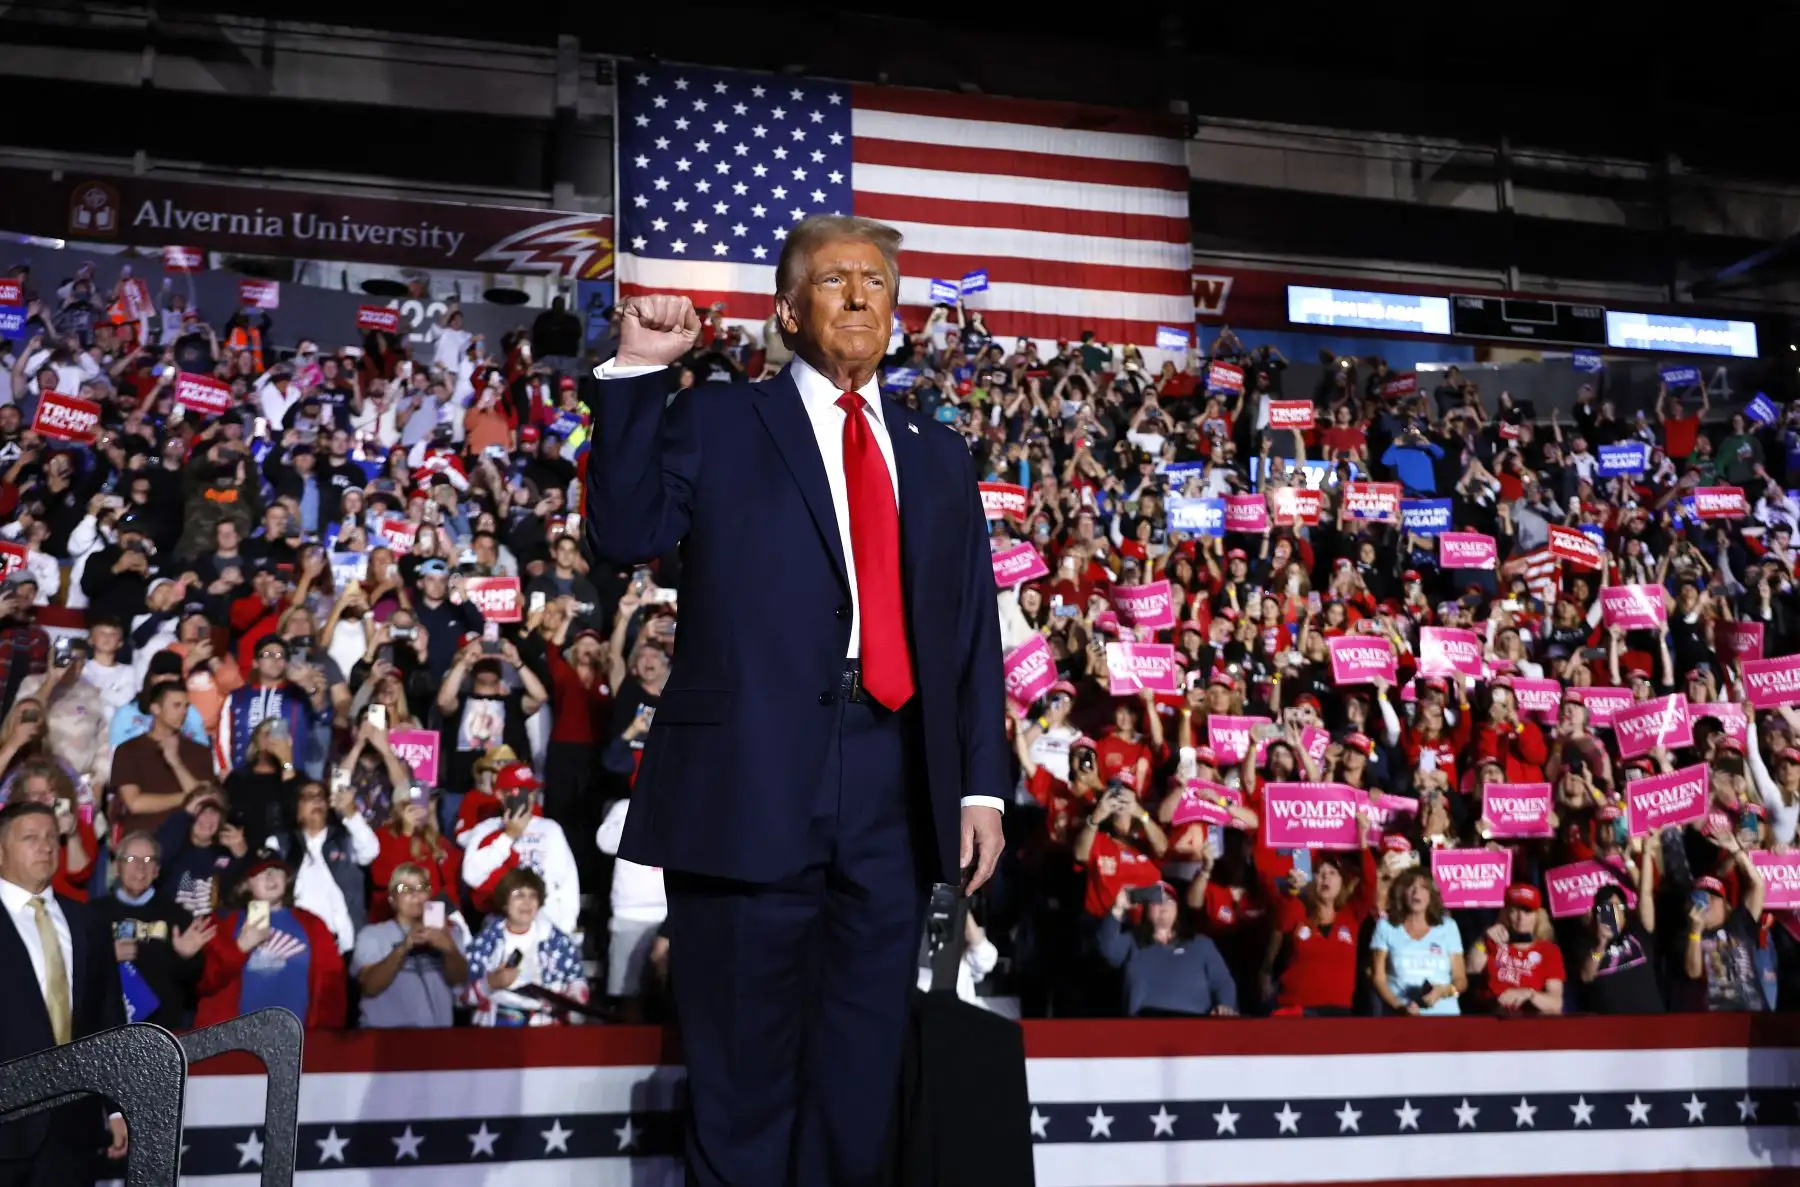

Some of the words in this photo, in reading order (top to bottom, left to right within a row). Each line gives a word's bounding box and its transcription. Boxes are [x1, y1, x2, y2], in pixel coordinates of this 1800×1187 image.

[133, 199, 284, 237] Alvernia
[292, 211, 465, 257] University
[387, 299, 448, 342] 22
[42, 402, 98, 425] TRUMP
[1271, 408, 1312, 418] TRUMP
[1347, 493, 1378, 501] DREAM
[1348, 499, 1392, 511] AGAIN!
[1402, 508, 1432, 516] DREAM
[1404, 514, 1447, 527] AGAIN!
[384, 529, 415, 545] TRU
[1444, 540, 1492, 553] WOMEN
[1336, 646, 1391, 663] WOMEN
[1439, 640, 1478, 656] OMEN
[1747, 667, 1800, 689] WOME
[1584, 696, 1631, 709] OMEN
[1212, 728, 1249, 743] WOM
[391, 743, 433, 760] MEN
[1633, 778, 1704, 812] WOMEN
[1272, 800, 1356, 820] WOMEN
[1489, 797, 1548, 814] WOMEN
[1285, 818, 1299, 830] for
[1301, 818, 1344, 829] TRUMP
[1437, 863, 1506, 882] WOMEN
[1756, 864, 1800, 882] WOM
[1552, 871, 1619, 894] WOME
